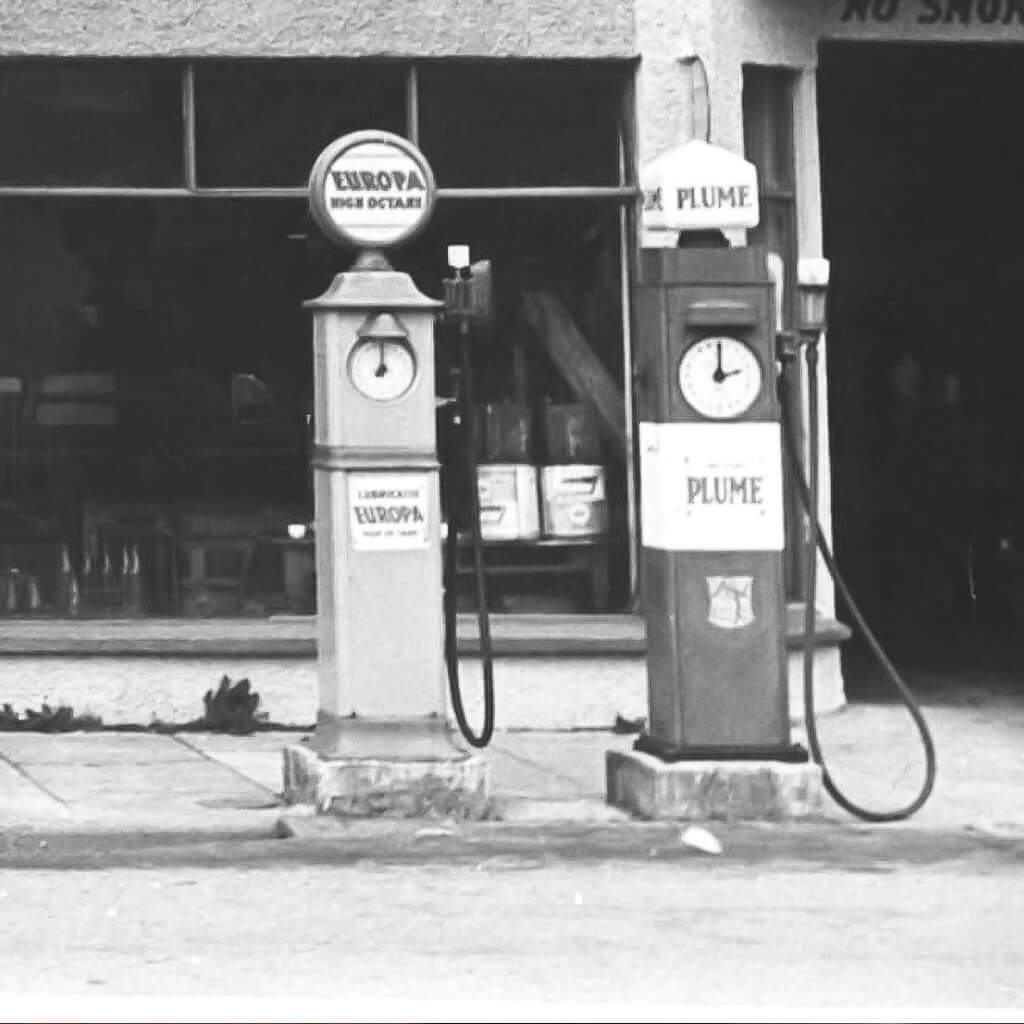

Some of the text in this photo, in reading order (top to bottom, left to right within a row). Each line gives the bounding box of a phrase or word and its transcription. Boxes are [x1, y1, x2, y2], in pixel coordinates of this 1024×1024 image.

[330, 170, 426, 191] EUROPA
[330, 197, 422, 209] HIGH OCTANE
[676, 185, 753, 210] PLUME
[687, 476, 763, 505] PLUME
[354, 505, 424, 525] EUROPA
